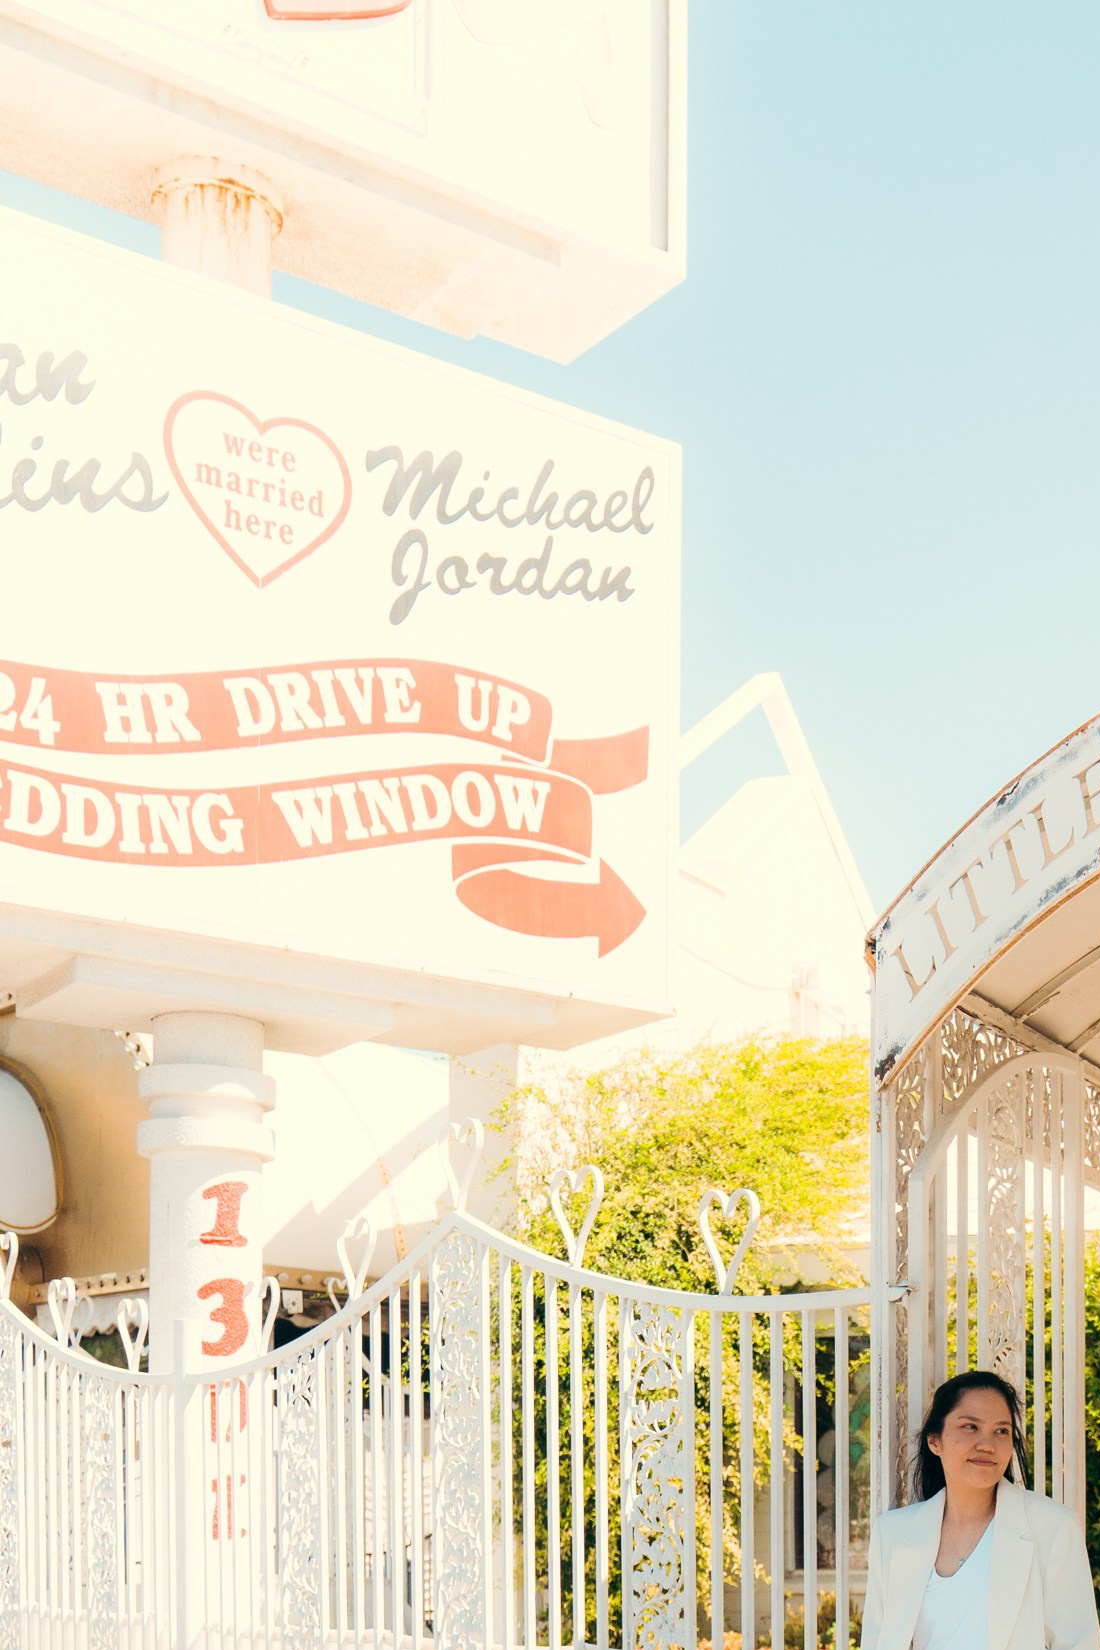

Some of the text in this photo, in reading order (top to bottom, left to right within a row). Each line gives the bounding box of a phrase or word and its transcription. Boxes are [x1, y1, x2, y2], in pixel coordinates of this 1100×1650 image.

[0, 422, 169, 513] ins
[195, 459, 325, 517] married
[223, 432, 296, 472] were
[365, 445, 654, 535] Michael
[224, 500, 294, 545] here
[388, 529, 635, 626] Jordan
[95, 682, 201, 743] HR
[223, 667, 421, 737] DRIVE
[454, 673, 532, 741] UP
[0, 769, 550, 854] DDING WINDOW
